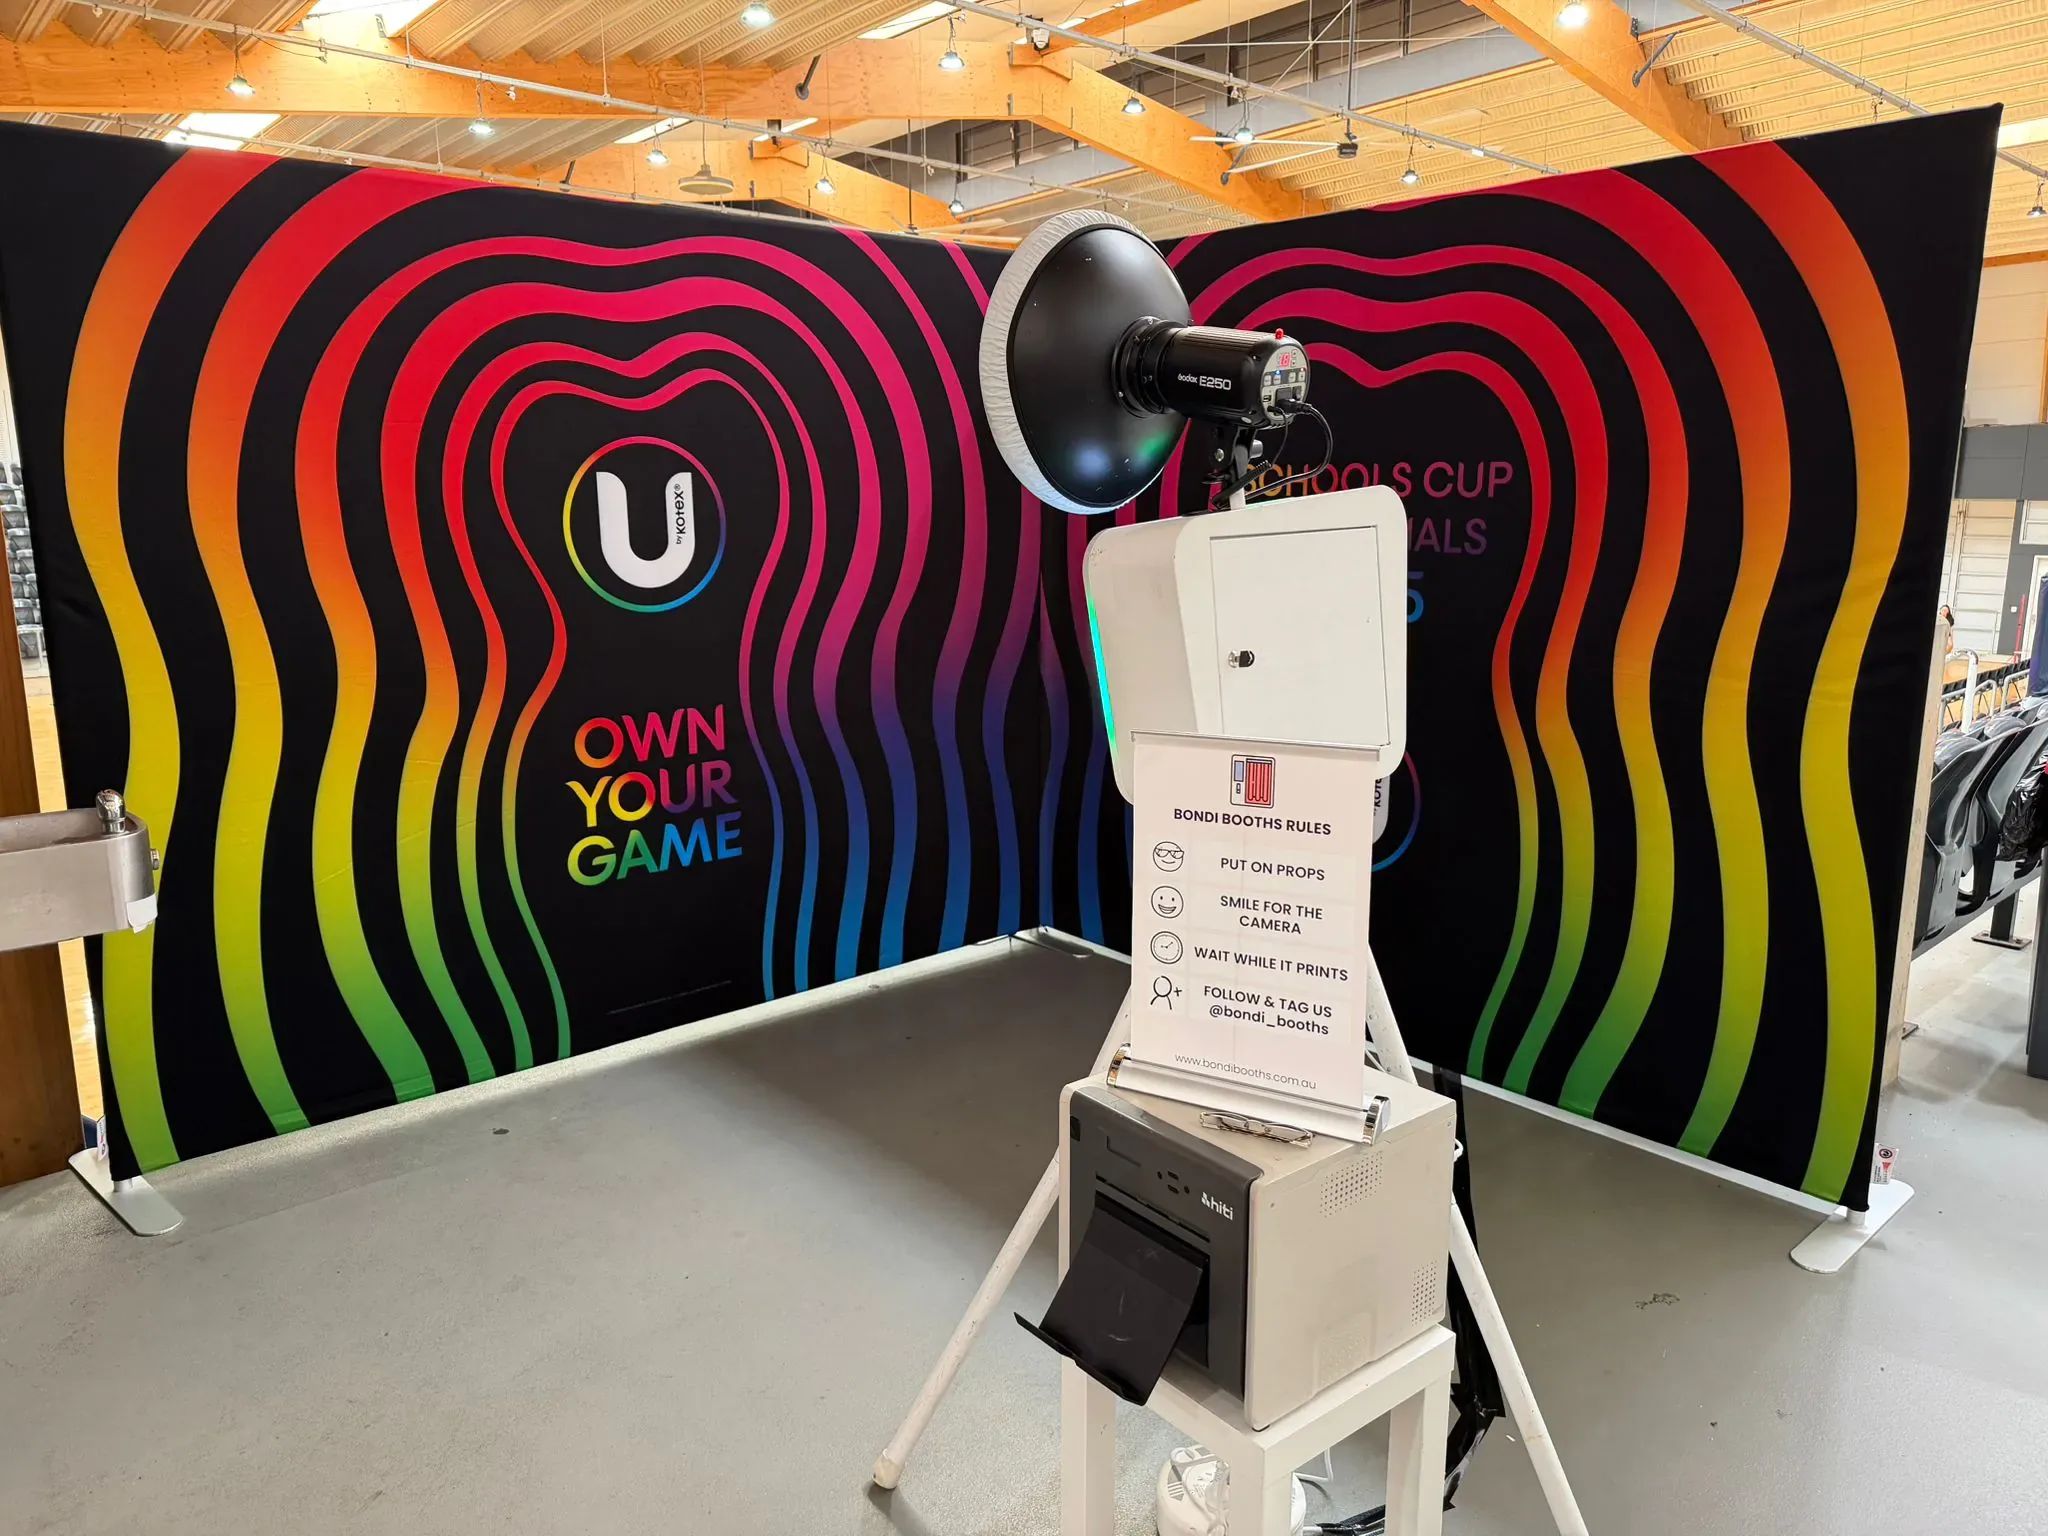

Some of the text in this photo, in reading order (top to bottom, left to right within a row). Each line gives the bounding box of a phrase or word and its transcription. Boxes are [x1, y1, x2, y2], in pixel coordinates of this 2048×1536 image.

[1199, 375, 1232, 391] E250
[1423, 461, 1514, 498] CUP
[574, 703, 726, 769] OWN
[565, 759, 739, 828] YOUR
[1174, 808, 1332, 835] BONDI BOOTHS RULES
[567, 811, 743, 886] GAME
[1220, 857, 1325, 881] PUT ON PROPS
[1220, 895, 1323, 920] SMILE FOR THE
[1239, 915, 1301, 935] CAMERA
[1194, 946, 1349, 982] WAIT WHILE IT PRINTS
[1203, 985, 1333, 1018] FOLLOW & TAG US
[1209, 1004, 1330, 1035] @bondi_booths
[1174, 1053, 1317, 1090] www.bondibooths.com.au
[1210, 1196, 1234, 1221] hiti
